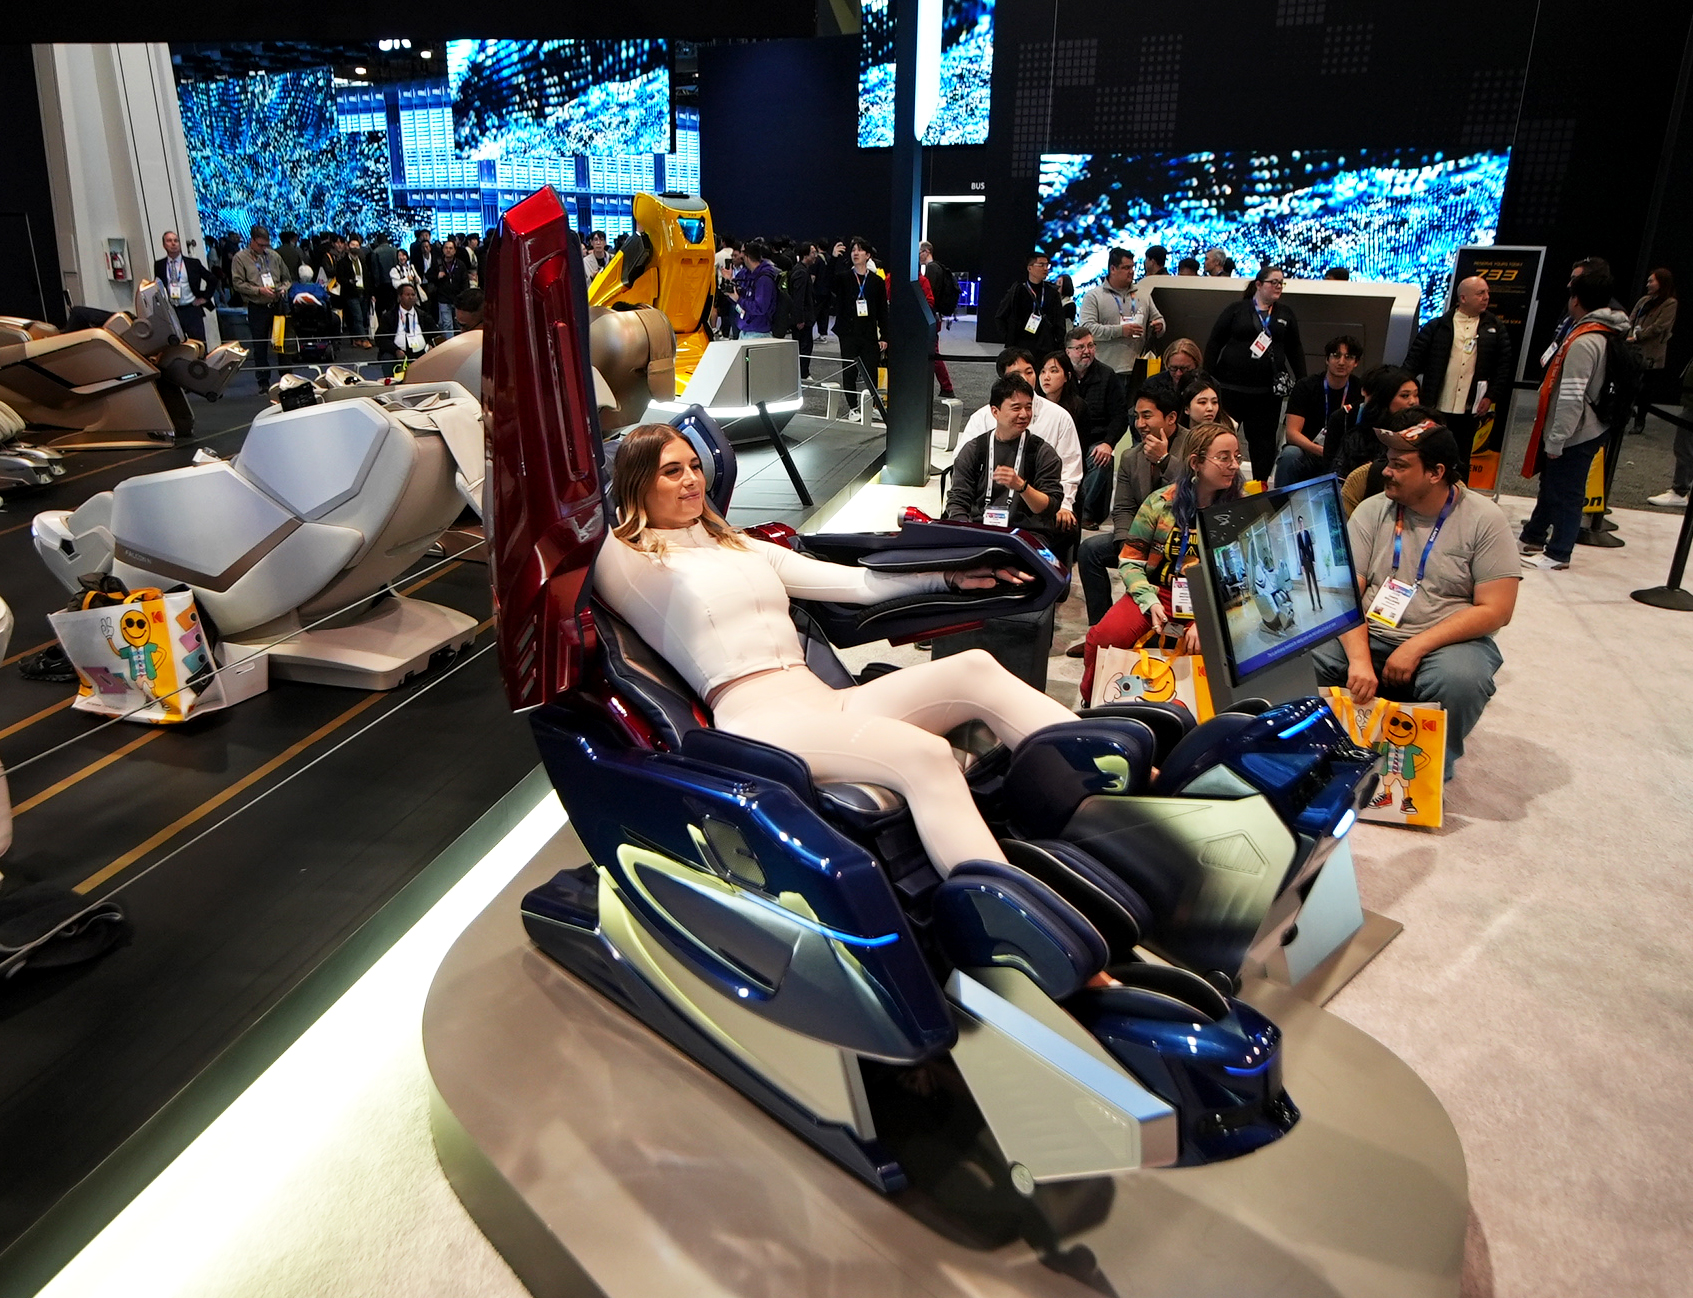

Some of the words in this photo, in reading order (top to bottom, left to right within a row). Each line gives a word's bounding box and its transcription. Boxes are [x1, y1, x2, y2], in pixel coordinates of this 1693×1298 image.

[971, 182, 985, 190] BUS
[1475, 268, 1519, 281] 733
[1429, 527, 1439, 542] SONY
